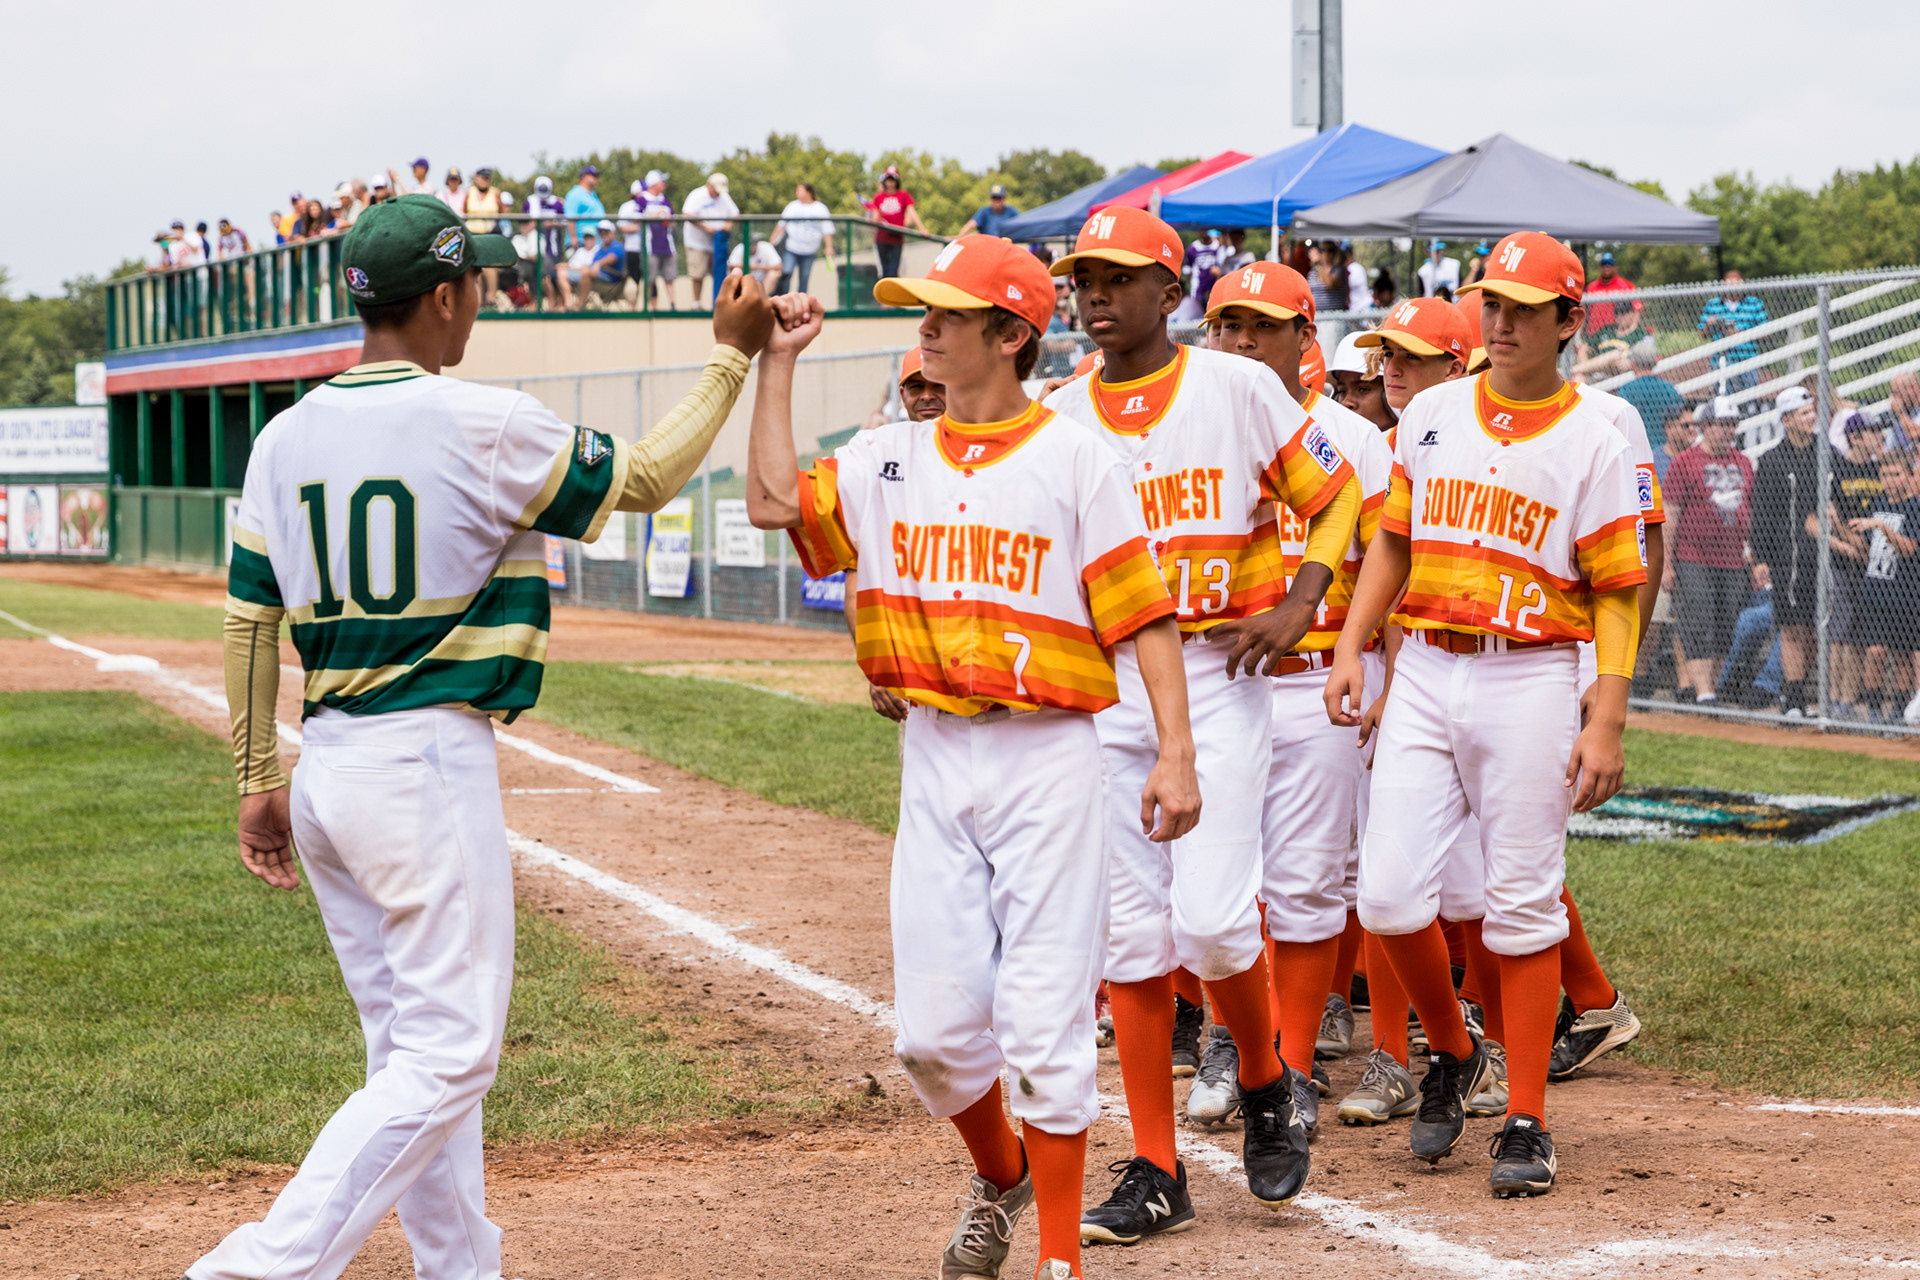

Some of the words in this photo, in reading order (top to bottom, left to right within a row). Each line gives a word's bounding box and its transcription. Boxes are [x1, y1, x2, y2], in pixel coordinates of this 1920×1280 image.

[1088, 212, 1117, 240] SW
[1499, 240, 1527, 273] SW
[1240, 268, 1266, 295] SW
[1394, 301, 1420, 327] SW
[1120, 405, 1150, 416] RUSSELL
[1133, 467, 1224, 532] HWEST
[1421, 477, 1560, 554] SOUTHWEST
[297, 475, 420, 625] 10
[891, 519, 1053, 597] SUTHWEST
[1174, 557, 1232, 616] 13
[1490, 572, 1548, 637] 12
[1003, 630, 1032, 695] 7
